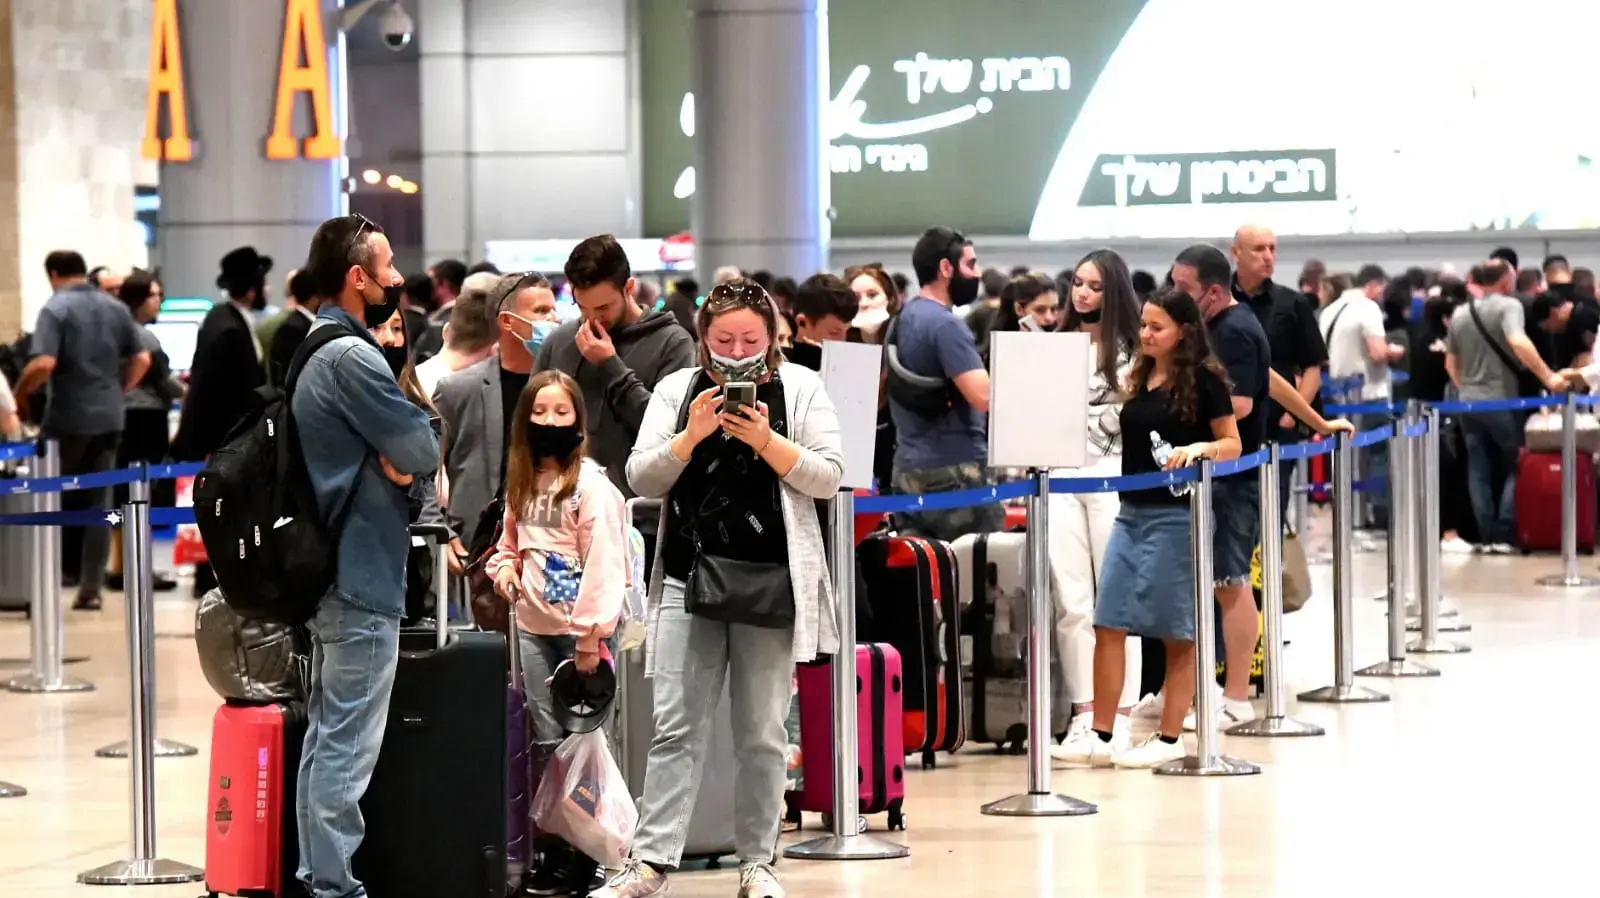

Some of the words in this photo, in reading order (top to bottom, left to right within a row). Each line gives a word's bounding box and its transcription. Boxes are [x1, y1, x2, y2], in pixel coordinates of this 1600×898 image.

[142, 0, 192, 161] A
[266, 0, 341, 160] A
[893, 51, 973, 103] שלך
[979, 56, 1071, 92] הבית
[1101, 154, 1181, 206] שלך
